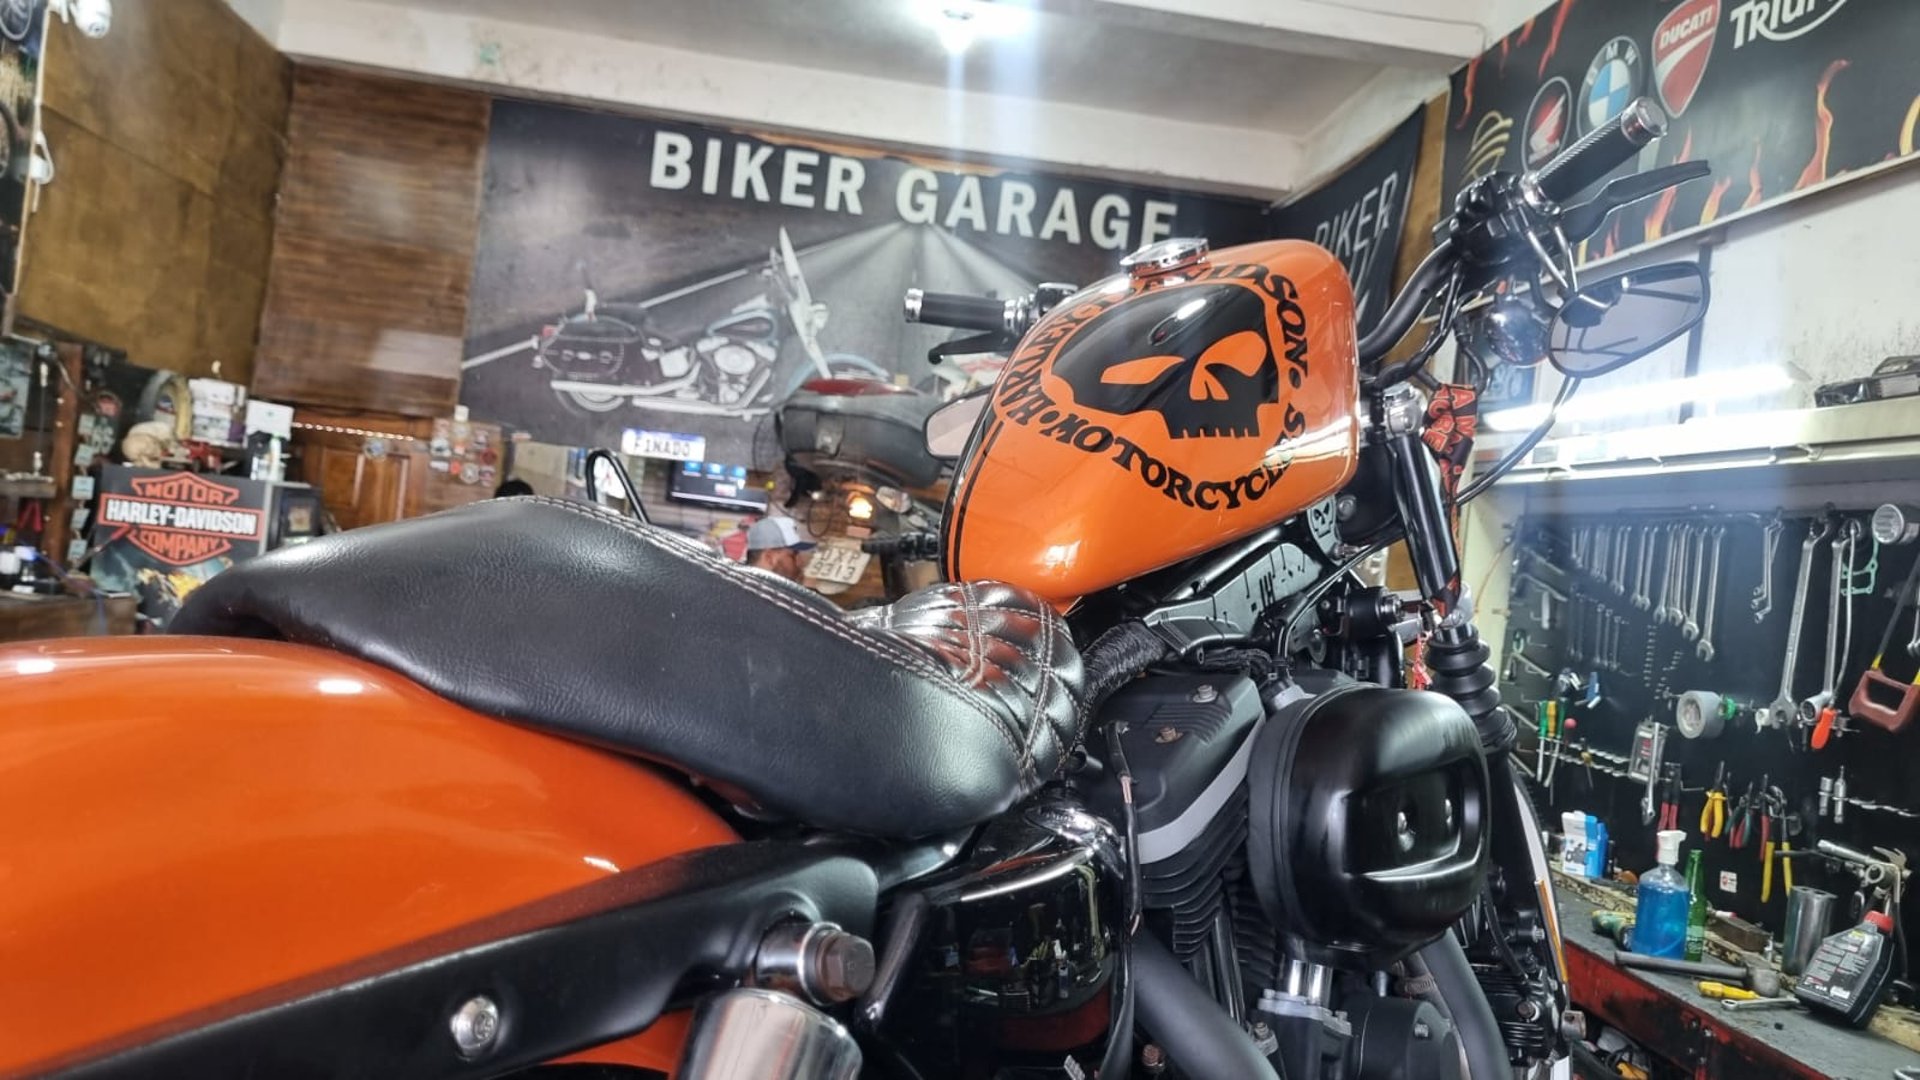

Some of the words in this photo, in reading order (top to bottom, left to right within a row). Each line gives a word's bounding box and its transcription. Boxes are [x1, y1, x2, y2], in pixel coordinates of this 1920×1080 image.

[1659, 5, 1713, 50] DUCATI
[1586, 41, 1637, 86] BMW
[651, 130, 866, 215] BIKER
[896, 167, 1178, 250] GARAGE
[144, 478, 225, 504] MOTOR
[105, 498, 257, 536] HARLEY-DAVIDSON
[139, 529, 220, 560] COMPANY
